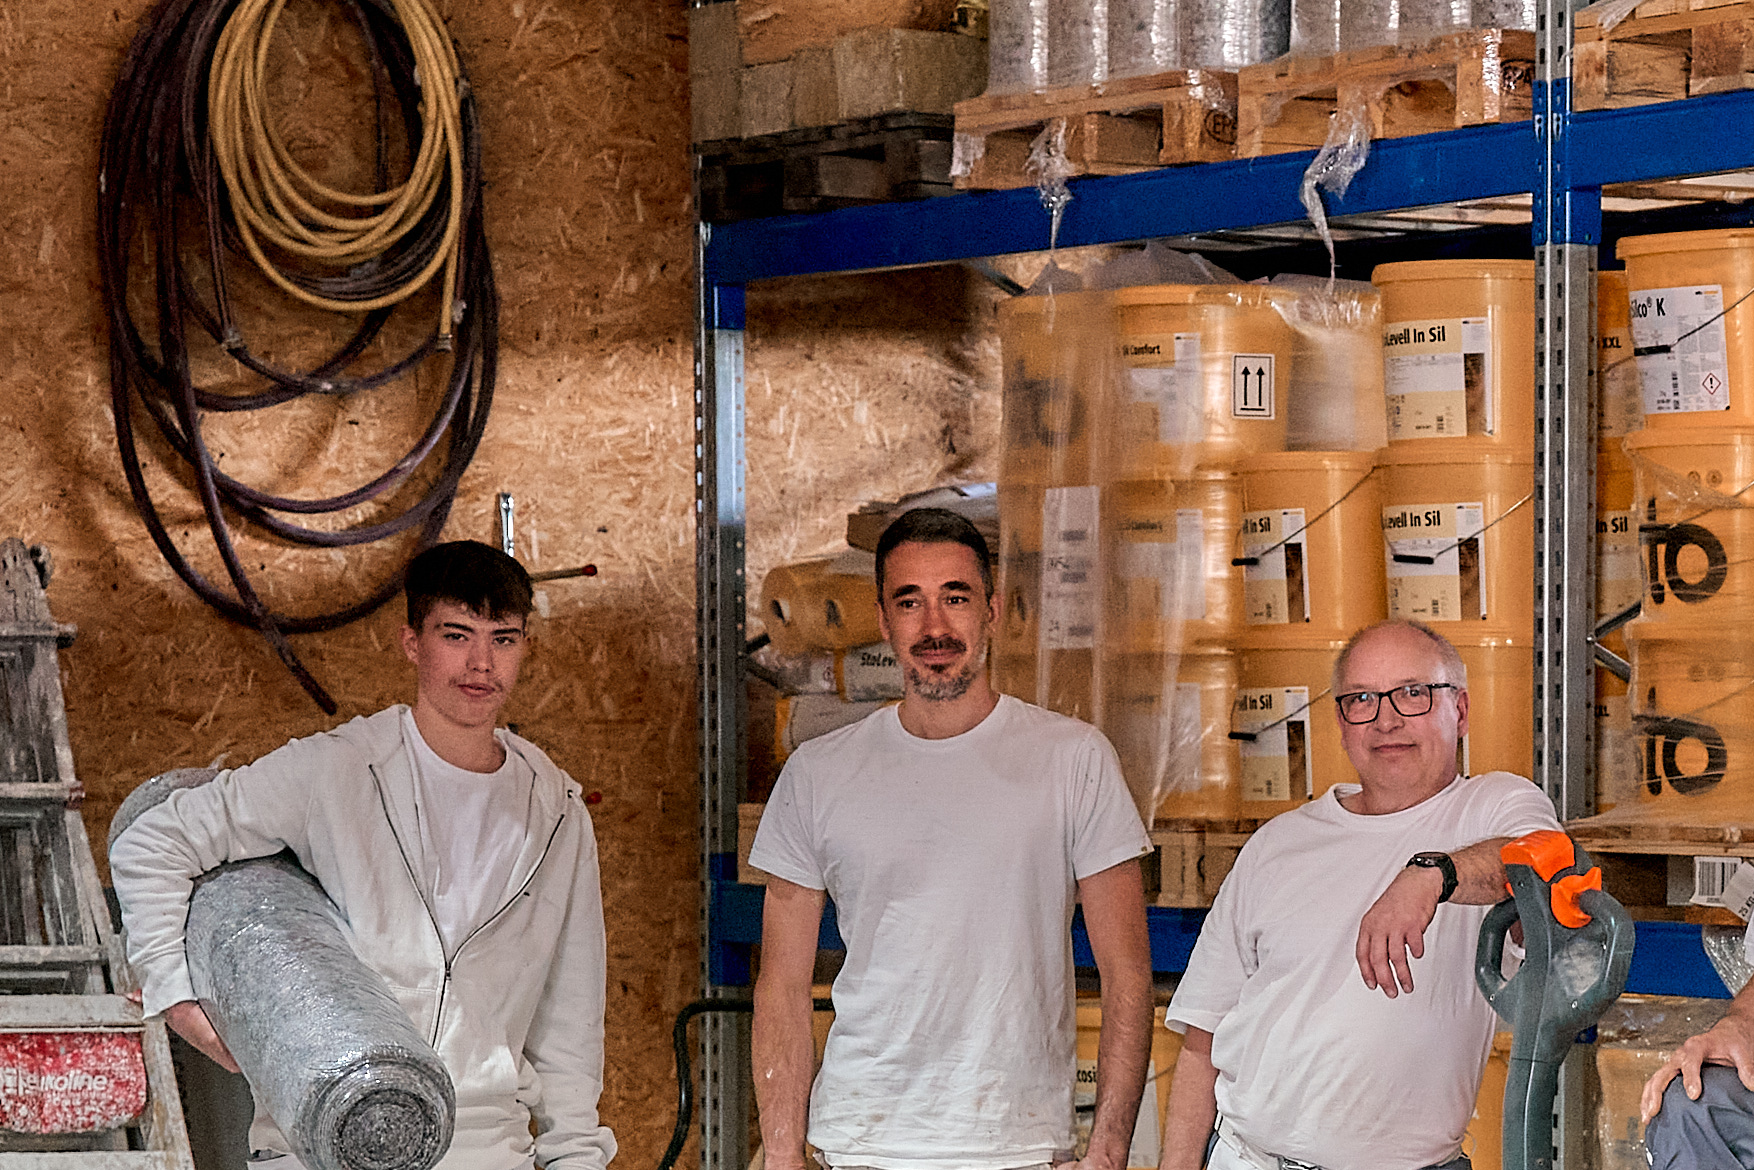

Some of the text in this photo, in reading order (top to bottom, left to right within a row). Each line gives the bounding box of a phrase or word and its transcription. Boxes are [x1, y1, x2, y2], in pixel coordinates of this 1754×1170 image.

[1656, 298, 1665, 316] K
[1384, 325, 1446, 347] Levell In Sil
[1259, 517, 1271, 532] Sil
[1410, 512, 1421, 526] In
[1424, 510, 1441, 526] Sil
[1611, 516, 1628, 533] Sil
[1260, 694, 1272, 710] Sil
